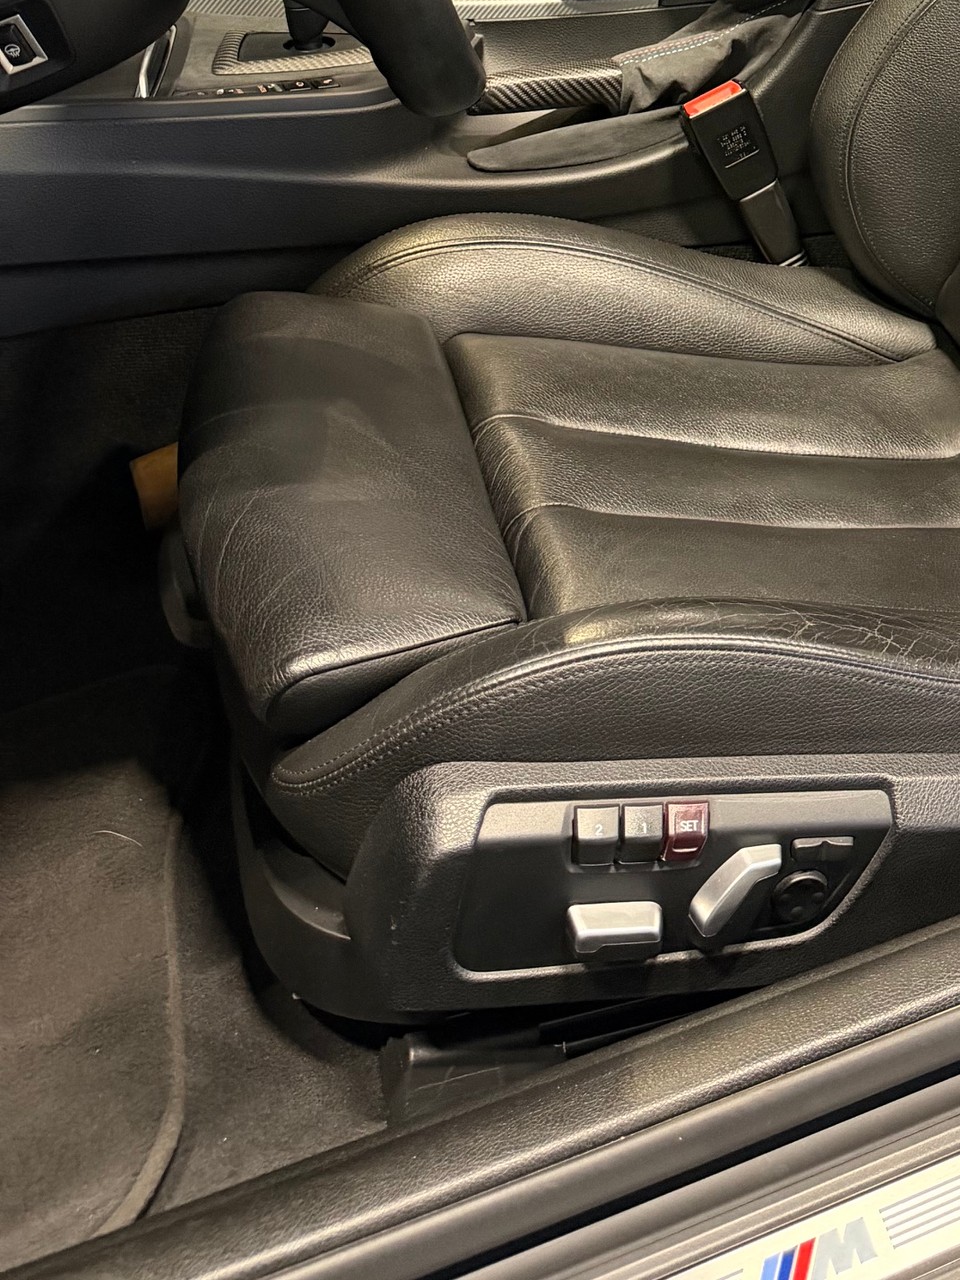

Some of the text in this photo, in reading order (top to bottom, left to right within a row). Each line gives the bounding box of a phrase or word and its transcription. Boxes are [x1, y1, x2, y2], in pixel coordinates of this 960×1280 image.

[595, 824, 604, 836] 2
[641, 822, 648, 834] 1
[679, 819, 699, 832] SET
[811, 1217, 878, 1280] M
